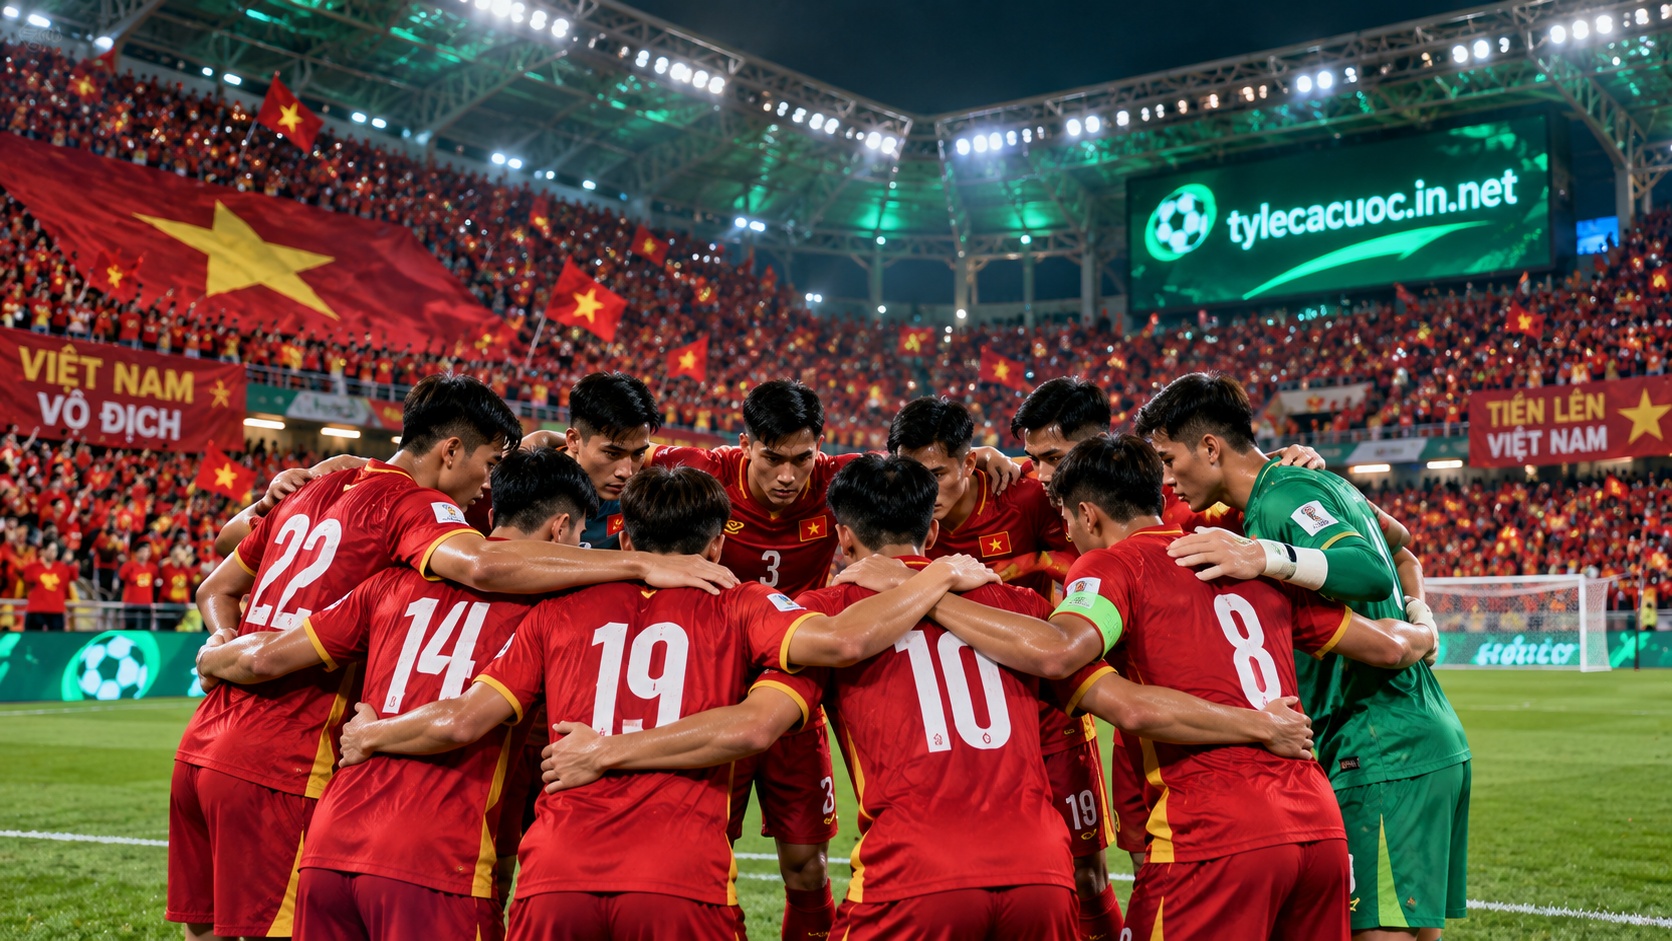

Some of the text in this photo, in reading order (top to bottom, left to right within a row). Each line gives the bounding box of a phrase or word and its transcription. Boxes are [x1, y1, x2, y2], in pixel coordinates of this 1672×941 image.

[1227, 168, 1518, 250] tylecacuoc.in.net
[18, 344, 194, 404] VIỆT NAM
[1554, 387, 1605, 423] LÊN
[99, 401, 181, 443] ĐỊCH
[1487, 425, 1607, 462] VIỆT NAM
[245, 513, 342, 631] 22
[760, 550, 781, 588] 3
[381, 597, 491, 714] 14
[591, 621, 689, 737] 19
[1213, 592, 1282, 711] 8
[894, 629, 1012, 753] 10
[1065, 789, 1097, 830] 19
